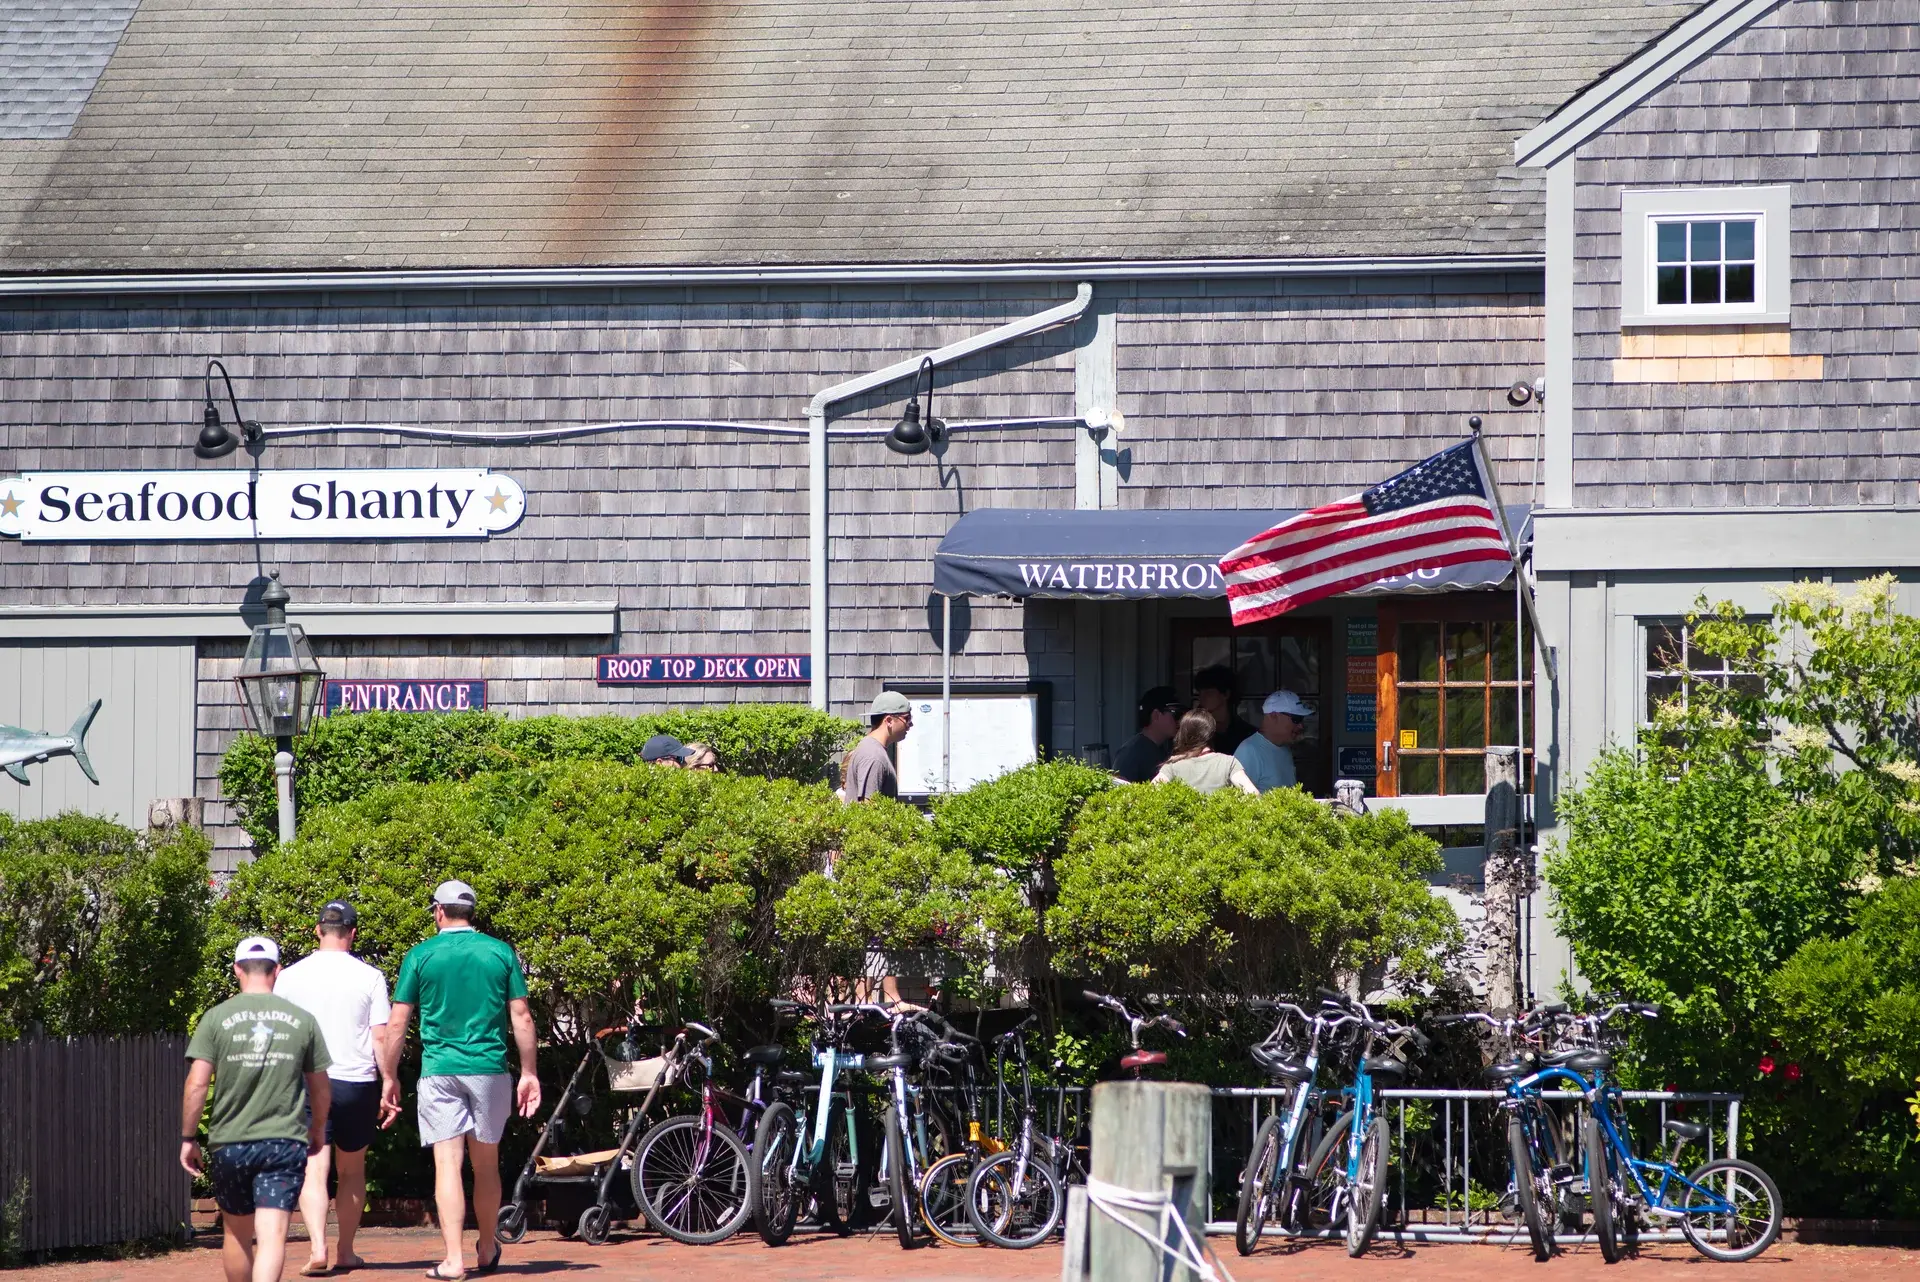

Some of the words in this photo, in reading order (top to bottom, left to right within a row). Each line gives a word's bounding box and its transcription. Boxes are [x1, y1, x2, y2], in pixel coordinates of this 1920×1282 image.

[38, 481, 259, 523] Seafood
[290, 480, 475, 529] Shanty
[1018, 563, 1225, 589] WATERFRON
[607, 658, 652, 679] ROOF
[661, 658, 696, 679] TOP
[703, 658, 749, 679] DECK
[754, 658, 801, 679] OPEN
[341, 684, 470, 711] ENTRANCE
[222, 1010, 248, 1030] SURF
[257, 1010, 301, 1029] SADDLE
